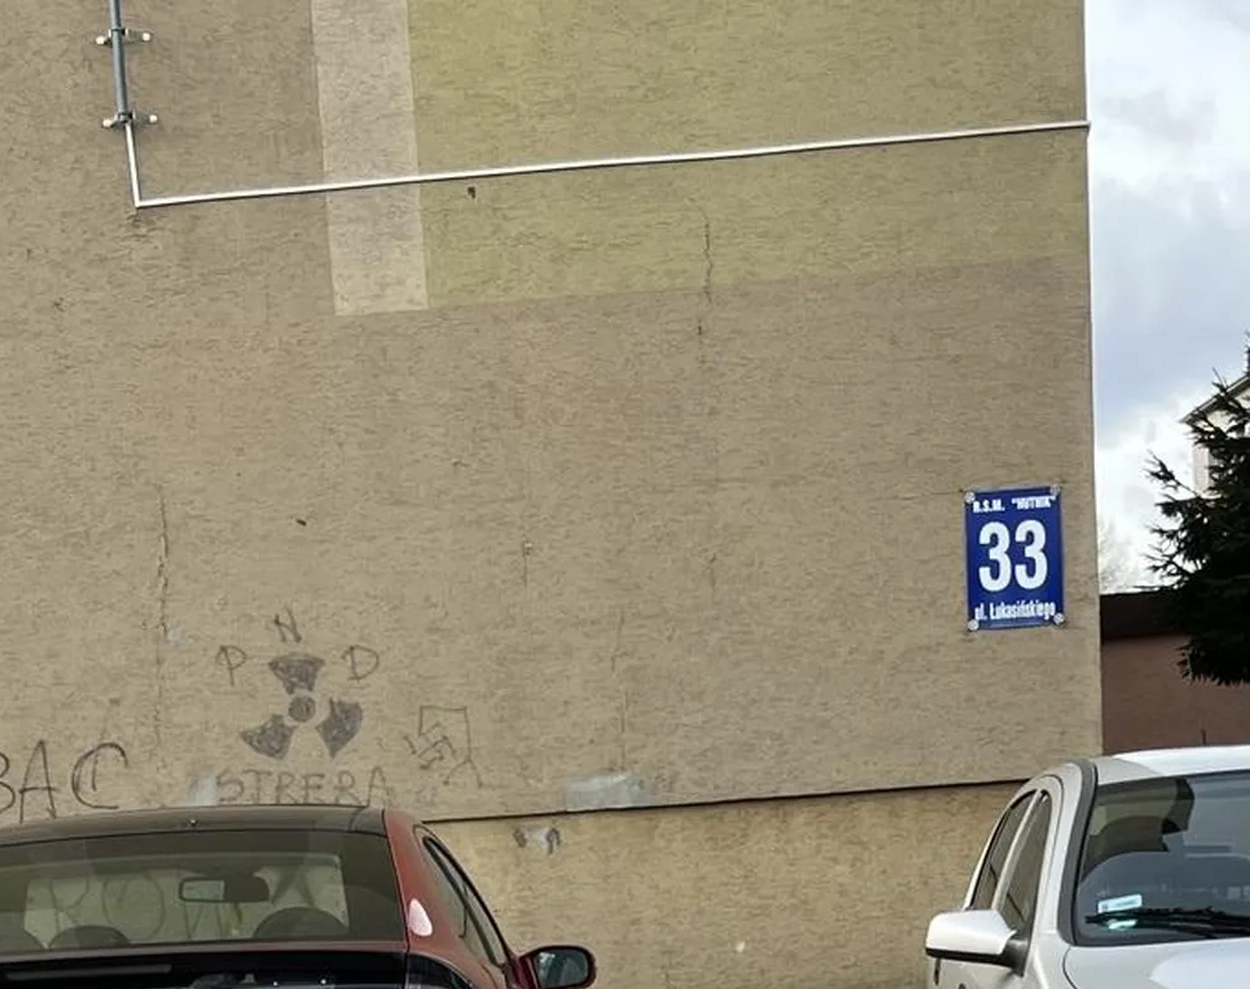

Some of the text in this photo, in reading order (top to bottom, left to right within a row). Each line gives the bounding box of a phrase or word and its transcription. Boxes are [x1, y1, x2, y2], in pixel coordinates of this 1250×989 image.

[978, 519, 1048, 591] 33
[215, 606, 380, 686] P N D
[975, 603, 988, 620] ul.
